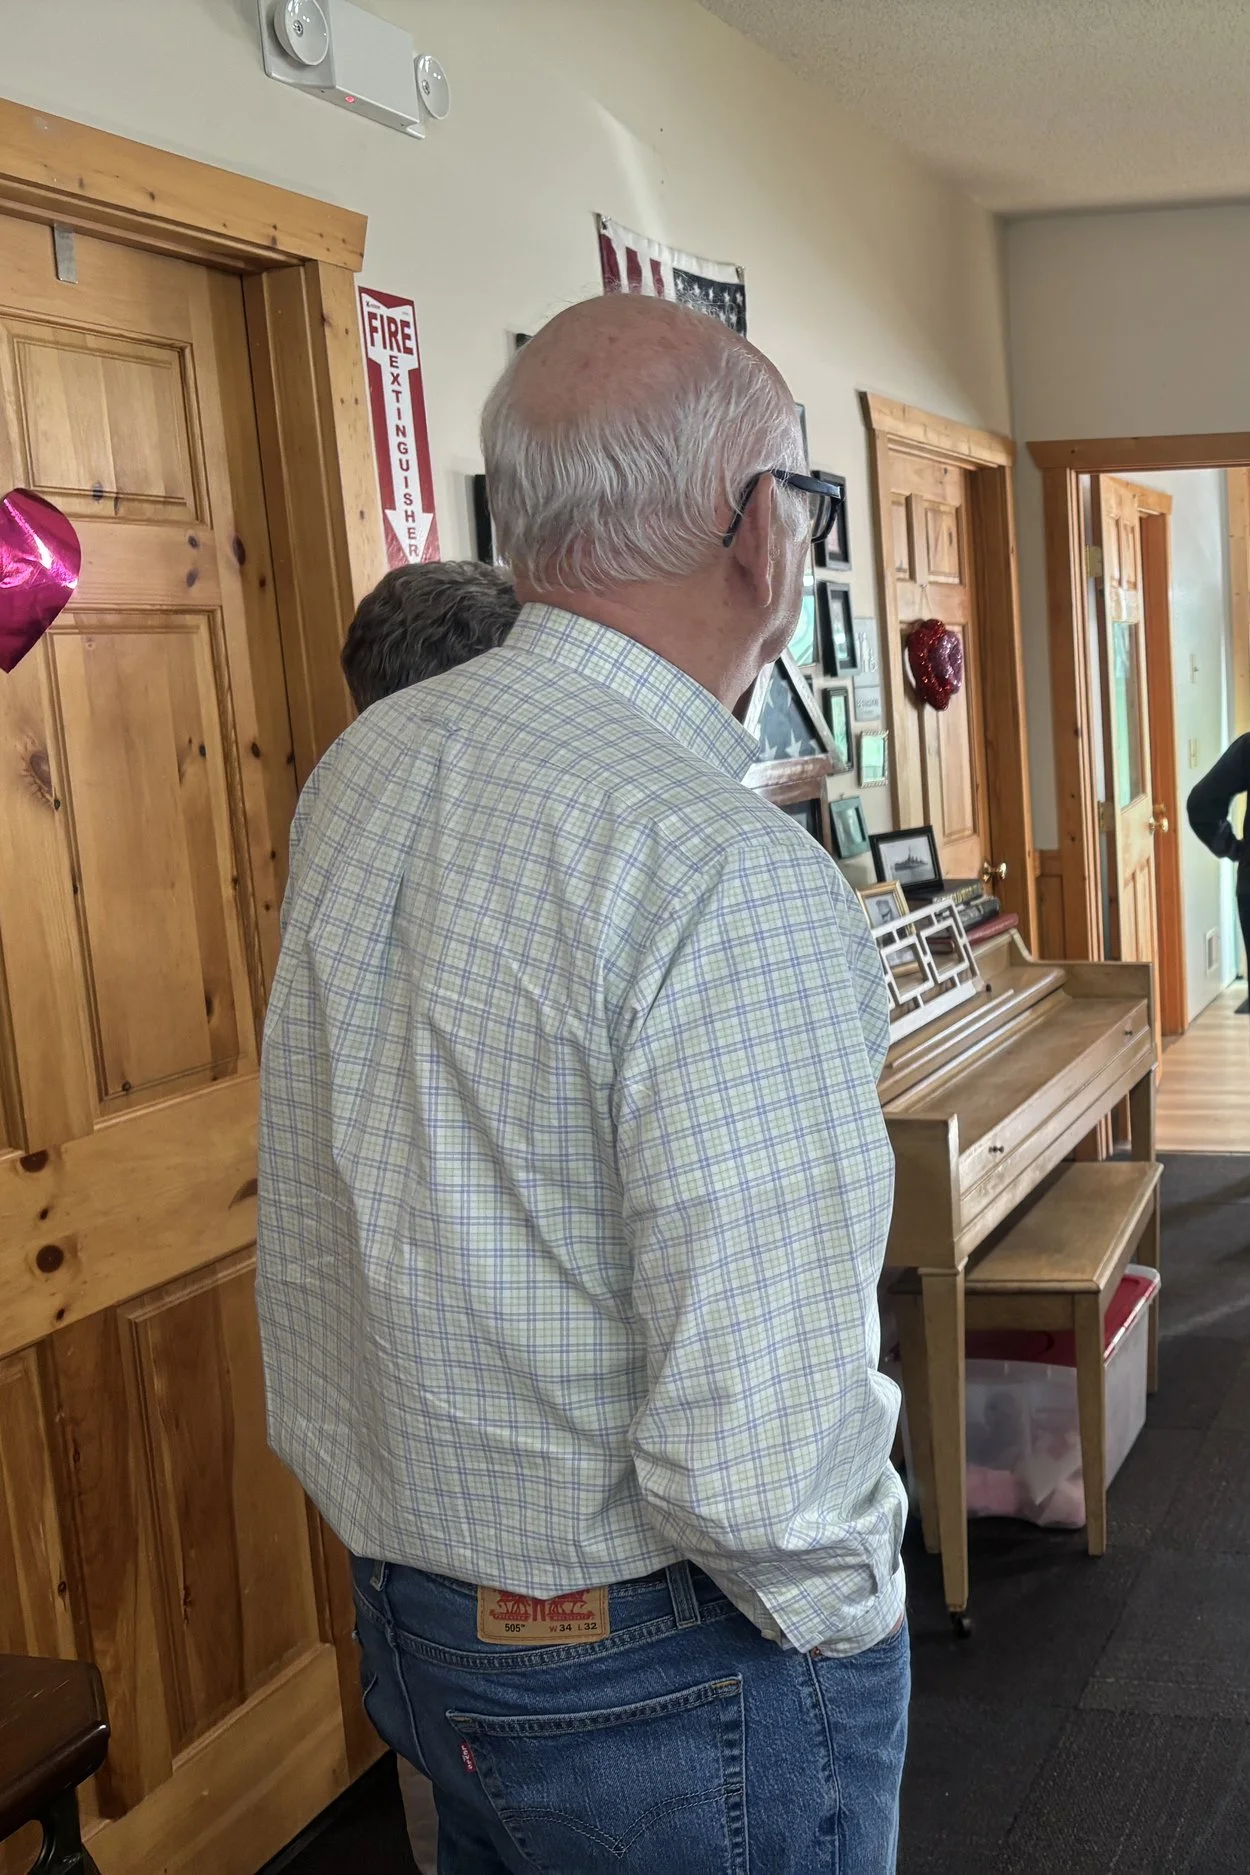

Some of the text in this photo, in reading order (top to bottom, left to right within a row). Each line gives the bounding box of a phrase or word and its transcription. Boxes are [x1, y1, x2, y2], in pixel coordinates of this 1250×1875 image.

[367, 311, 414, 356] FIRE
[389, 355, 419, 557] EXTINGUISHER
[559, 1623, 572, 1632] 34
[584, 1622, 597, 1630] 32
